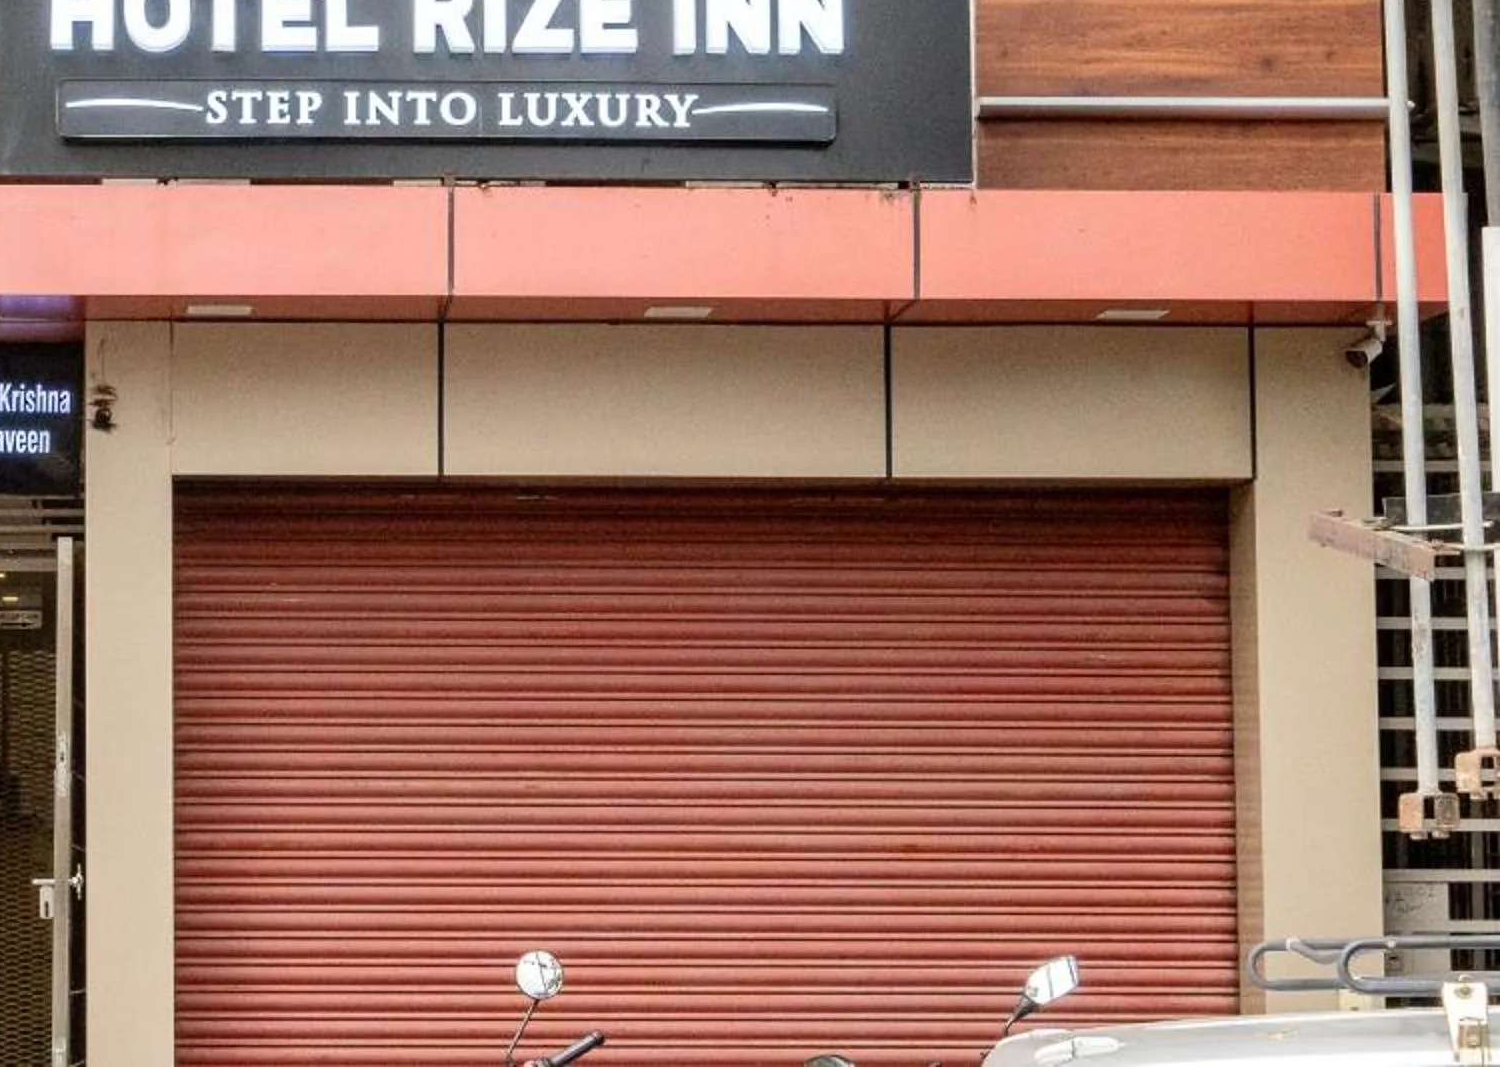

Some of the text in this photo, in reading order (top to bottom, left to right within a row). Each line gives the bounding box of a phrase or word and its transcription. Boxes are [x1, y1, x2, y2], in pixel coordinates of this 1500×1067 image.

[205, 88, 698, 129] STEP INTO LUXURY
